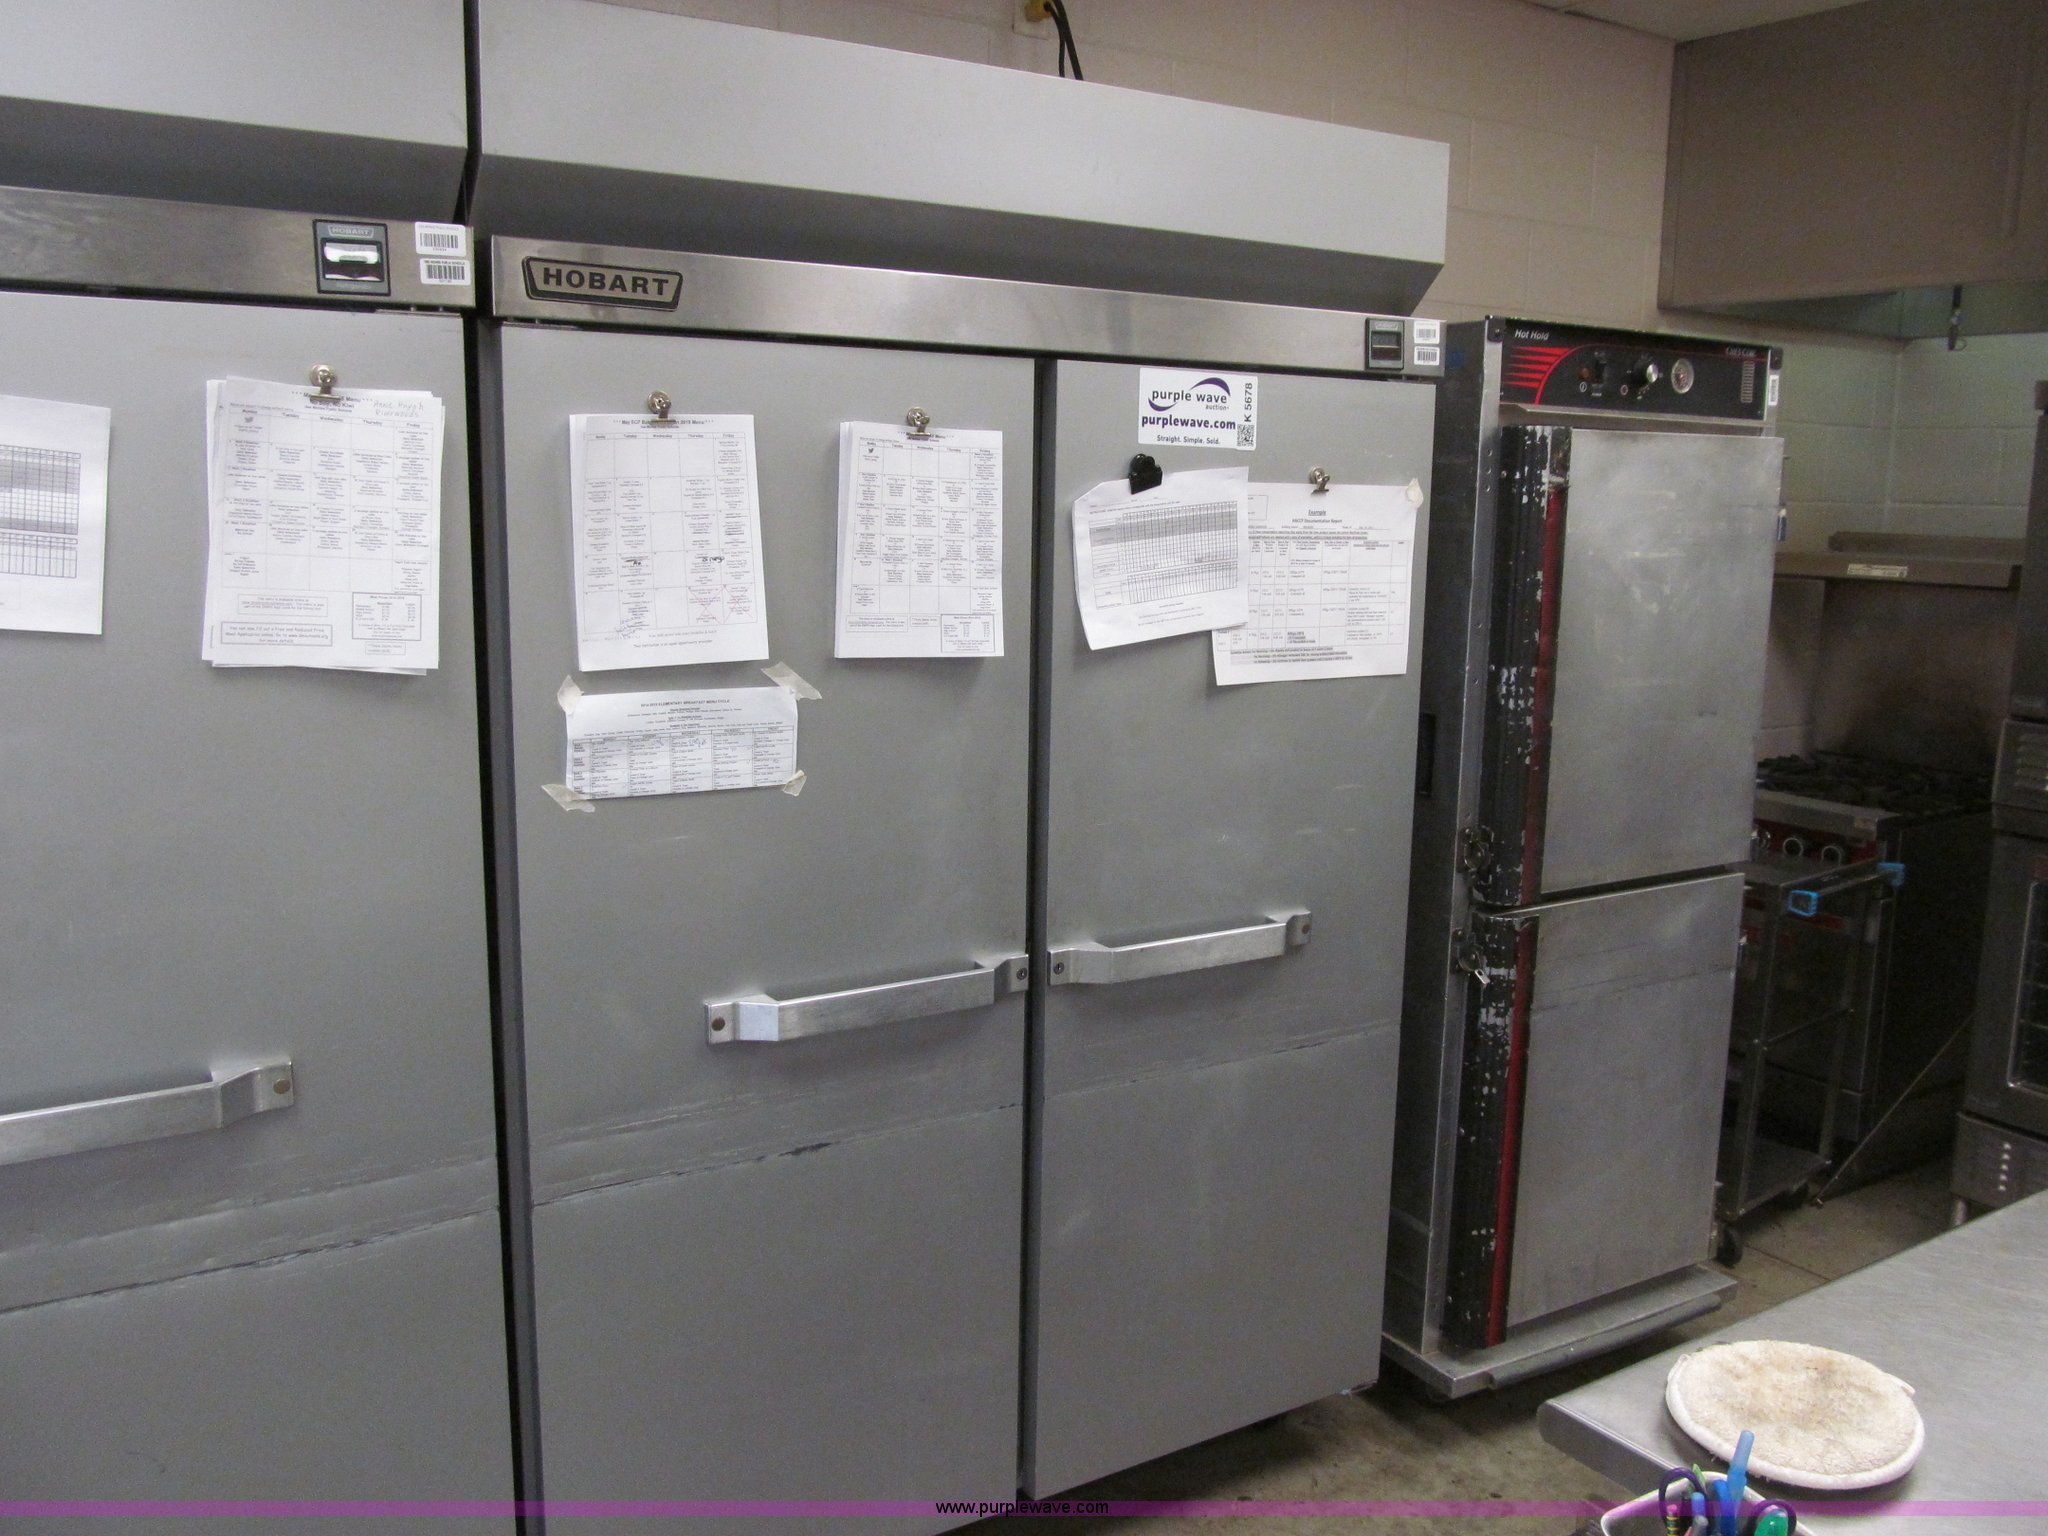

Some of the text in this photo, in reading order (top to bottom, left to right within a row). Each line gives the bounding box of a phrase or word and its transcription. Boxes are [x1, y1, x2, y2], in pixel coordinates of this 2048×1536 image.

[332, 228, 370, 236] HOBART
[543, 267, 669, 296] HOBART
[1514, 328, 1550, 341] Hot Hold
[1152, 389, 1227, 404] purple wave
[1244, 382, 1253, 422] K 5678
[1141, 414, 1236, 430] purplewave.com
[1157, 434, 1221, 445] Straight. Simple. Sold.
[1308, 509, 1327, 517] Example
